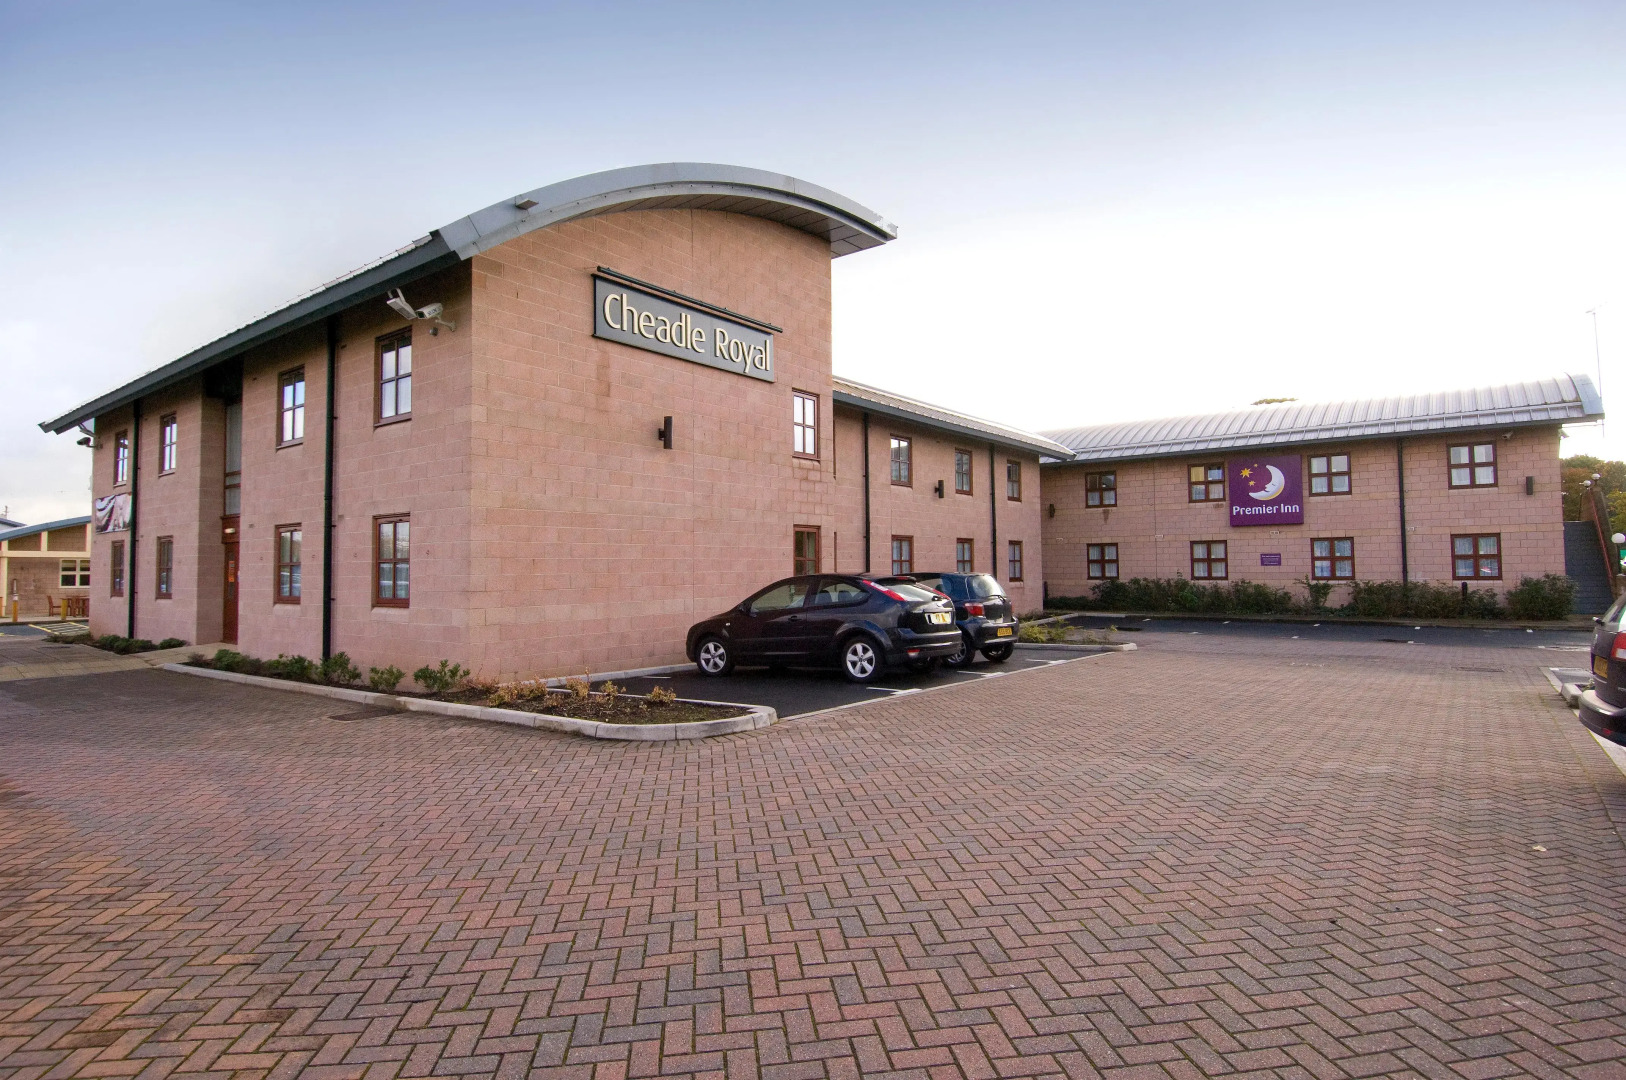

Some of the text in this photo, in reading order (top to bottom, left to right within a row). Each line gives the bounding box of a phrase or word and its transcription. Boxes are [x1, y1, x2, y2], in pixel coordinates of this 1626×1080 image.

[604, 293, 770, 373] Cheadle Royal
[1232, 503, 1299, 515] Premier Inn
